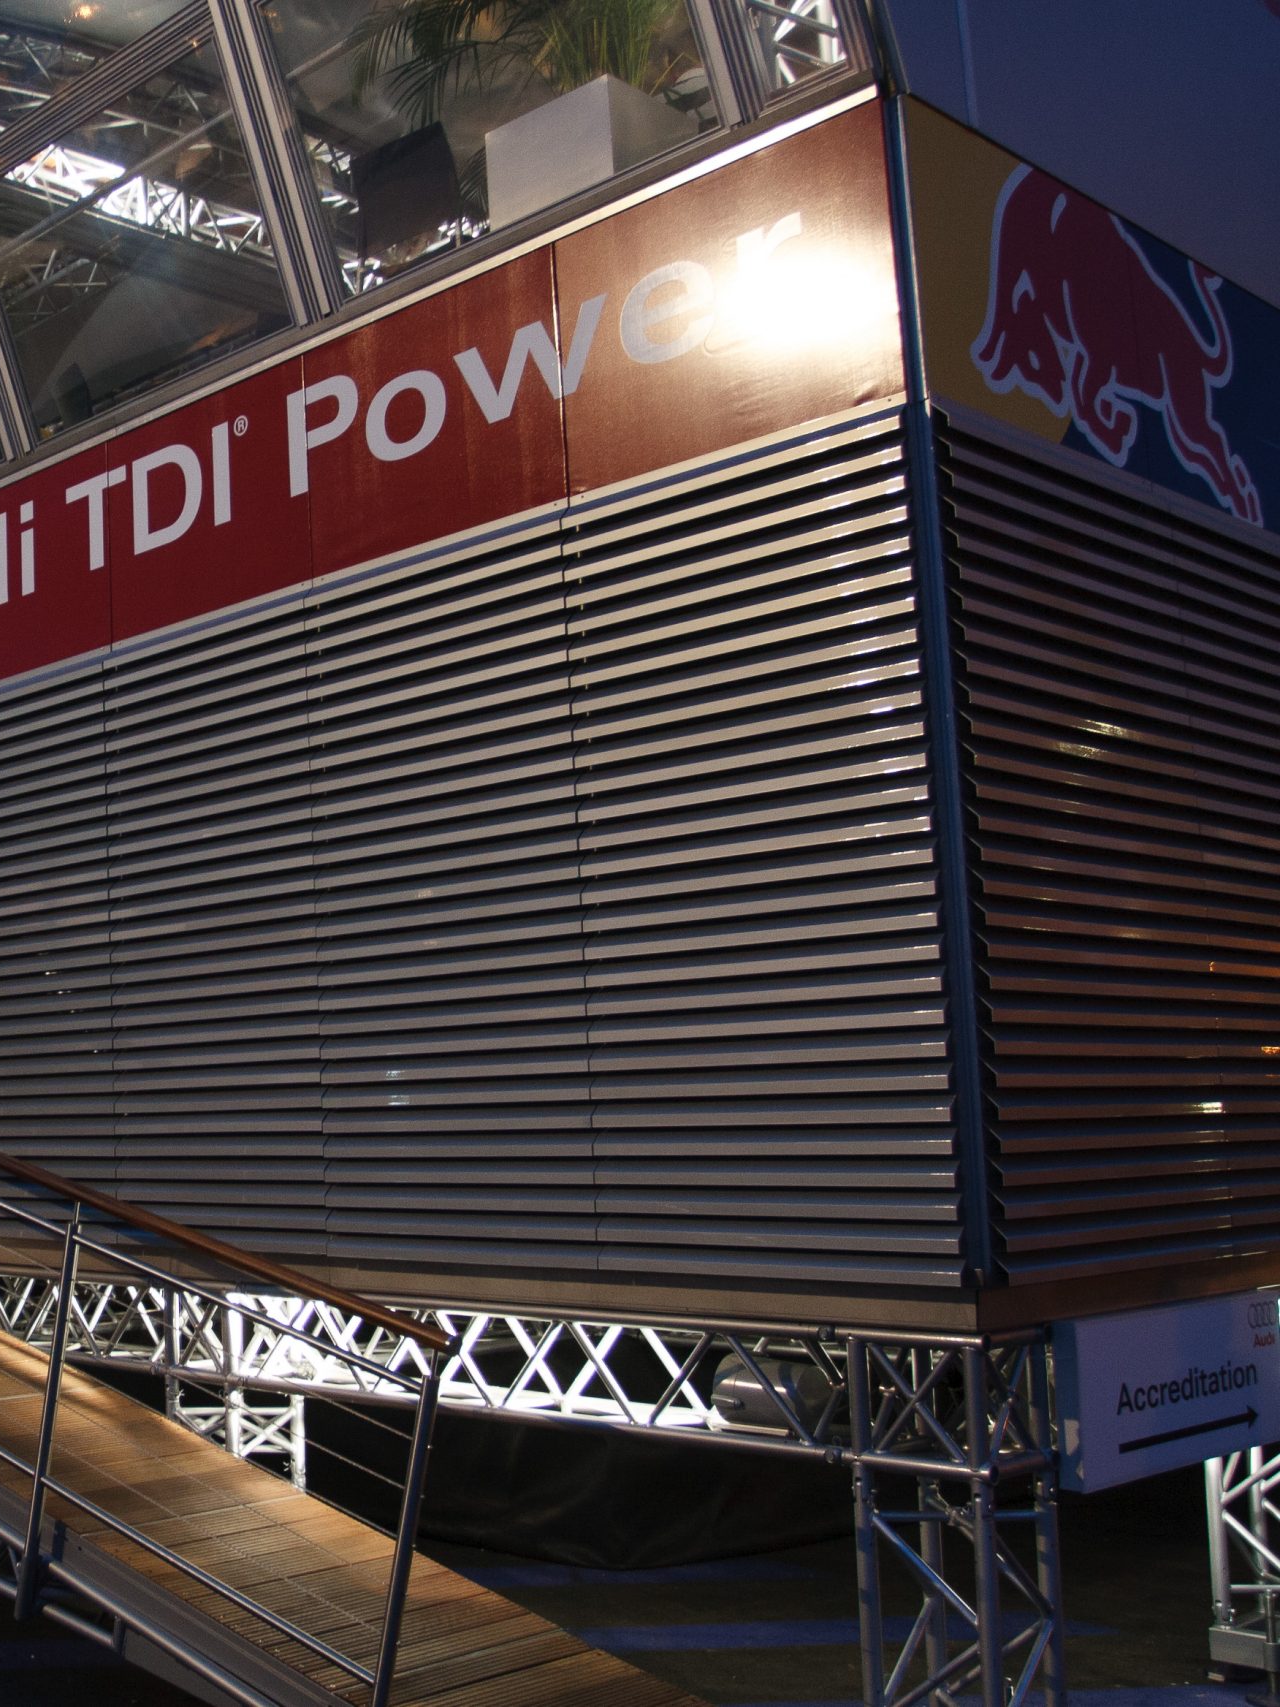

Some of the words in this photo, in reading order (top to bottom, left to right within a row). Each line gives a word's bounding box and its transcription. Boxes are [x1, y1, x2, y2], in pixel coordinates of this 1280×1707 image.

[286, 211, 803, 498] Power
[1252, 1331, 1276, 1348] Audi
[1116, 1360, 1259, 1416] Accreditation
